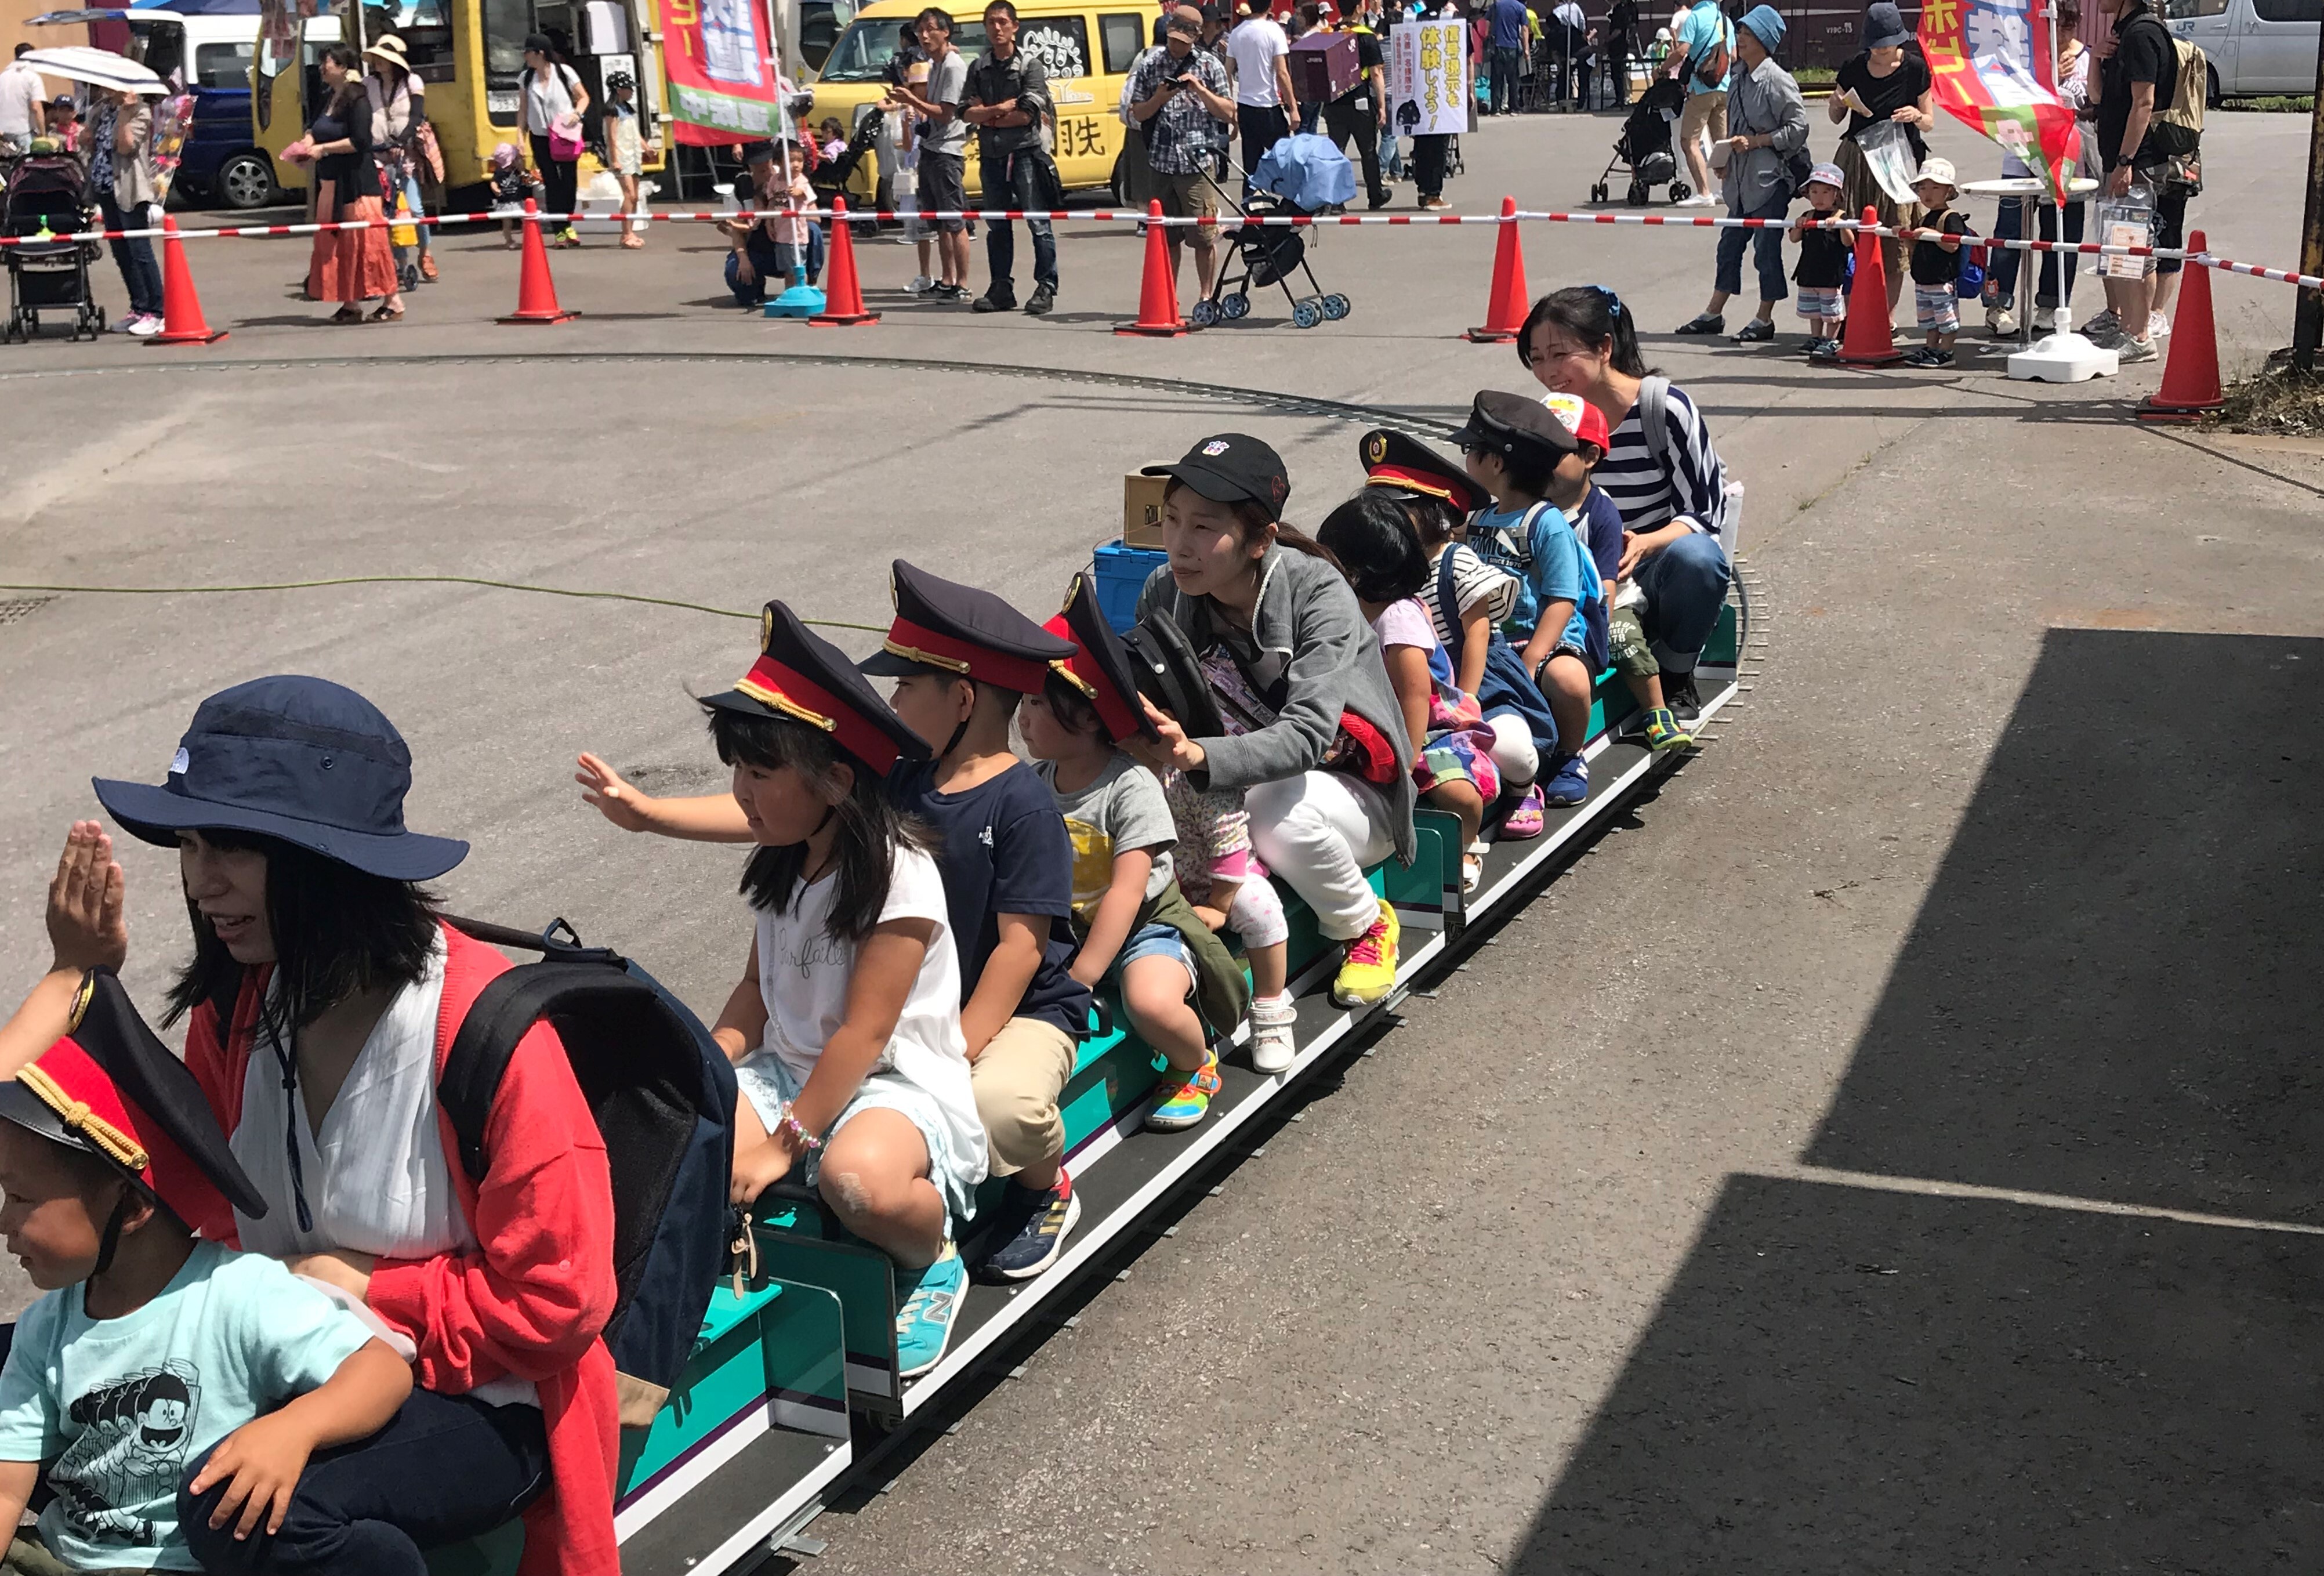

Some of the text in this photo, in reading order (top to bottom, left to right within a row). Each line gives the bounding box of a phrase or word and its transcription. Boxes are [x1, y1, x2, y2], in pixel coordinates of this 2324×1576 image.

[2176, 21, 2195, 31] JR
[2062, 79, 2083, 97] LIST
[1471, 536, 1520, 558] TOMIC
[1506, 560, 1522, 568] 1970
